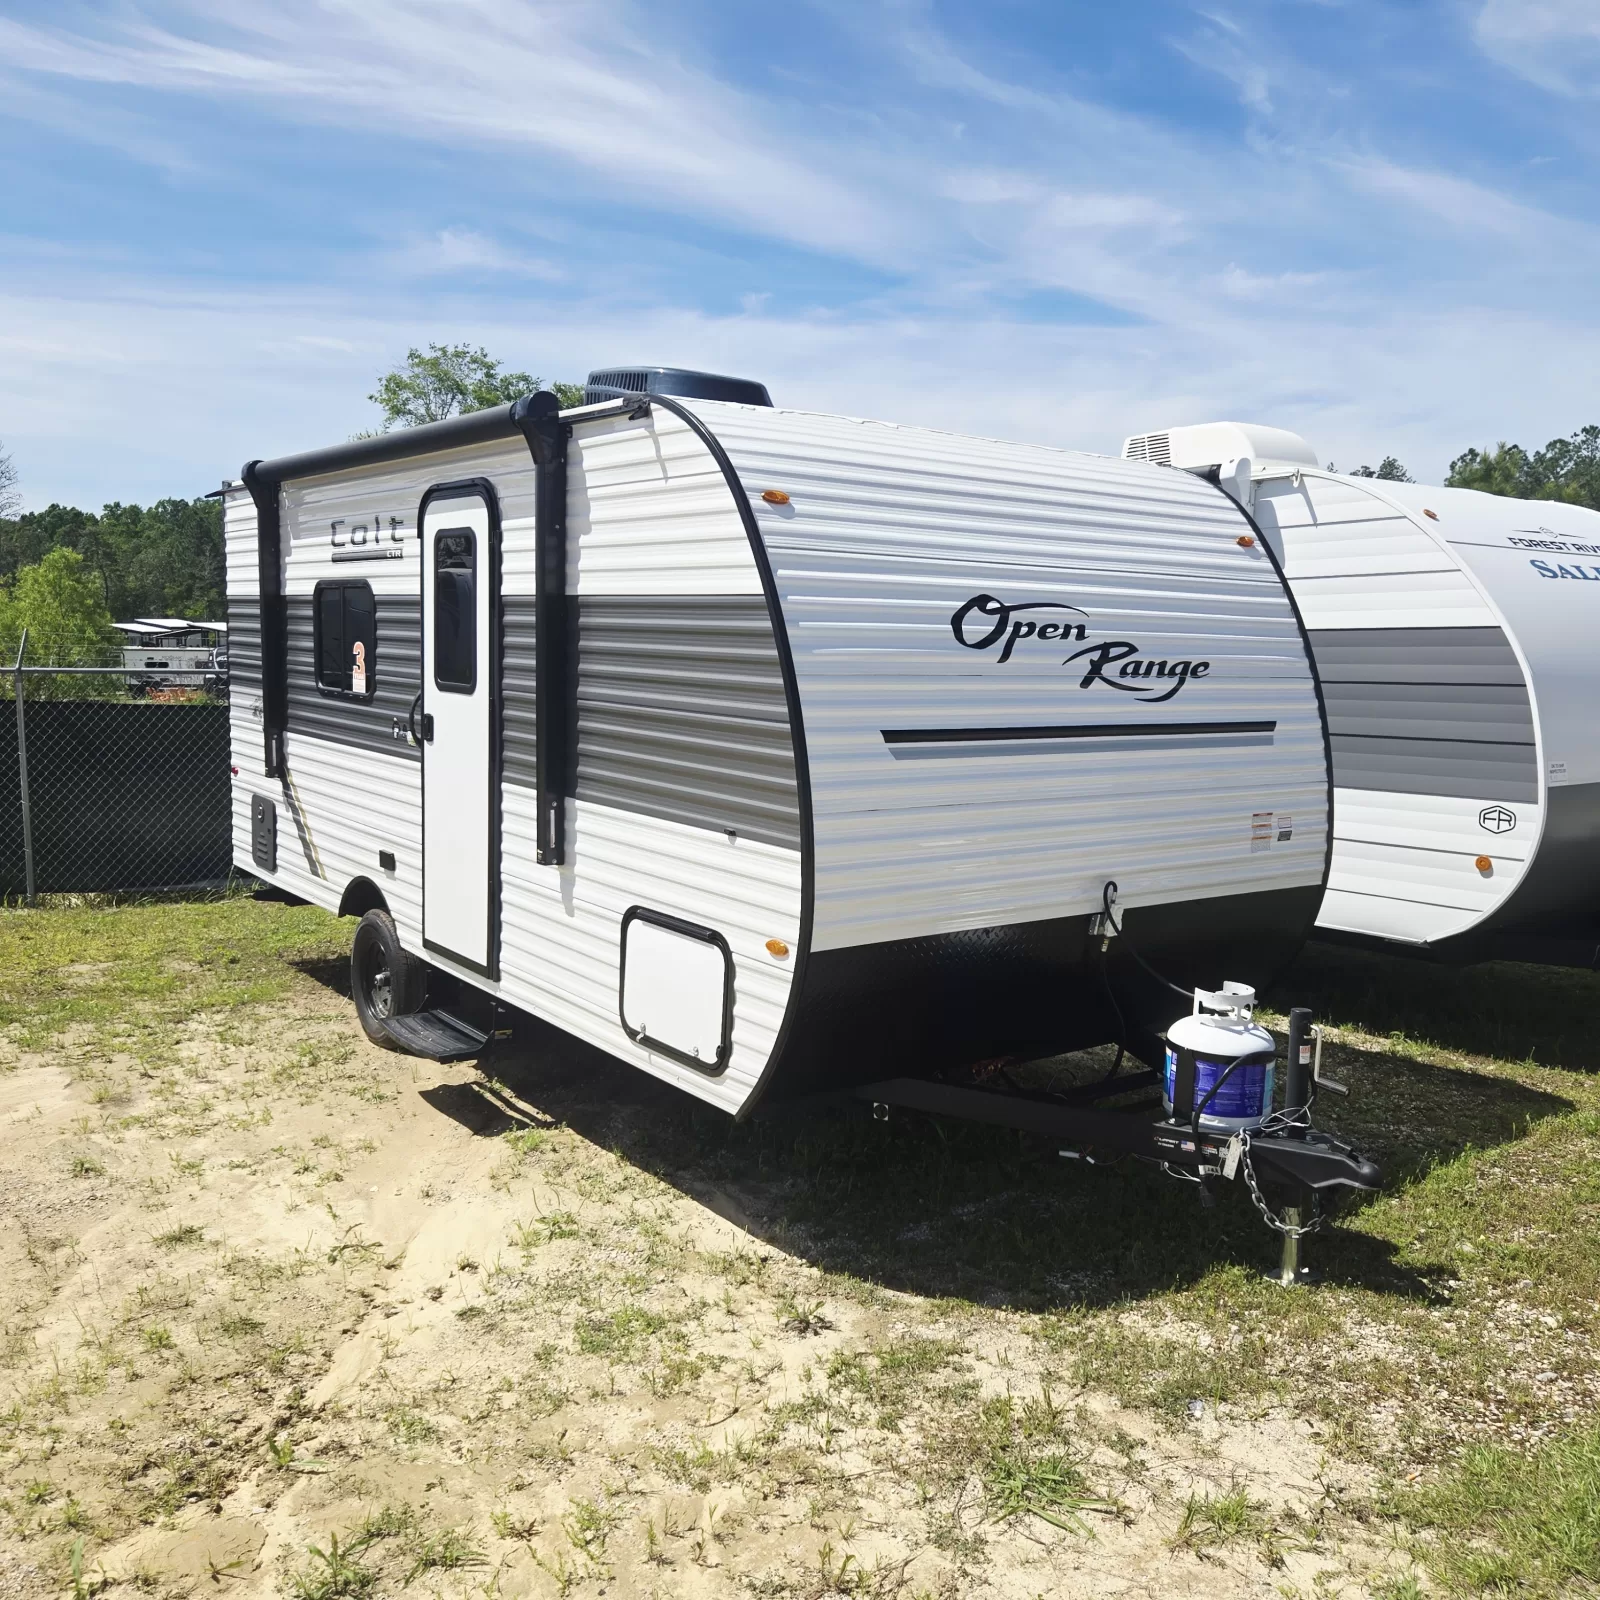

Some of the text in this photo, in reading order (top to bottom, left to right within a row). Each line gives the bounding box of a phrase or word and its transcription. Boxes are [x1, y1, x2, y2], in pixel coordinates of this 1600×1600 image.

[331, 515, 404, 547] Colt
[1506, 536, 1571, 551] FOREST
[386, 550, 402, 558] CTR
[951, 593, 1090, 663] Open
[352, 641, 366, 673] 3
[1062, 641, 1210, 702] Range
[1482, 808, 1513, 831] FR
